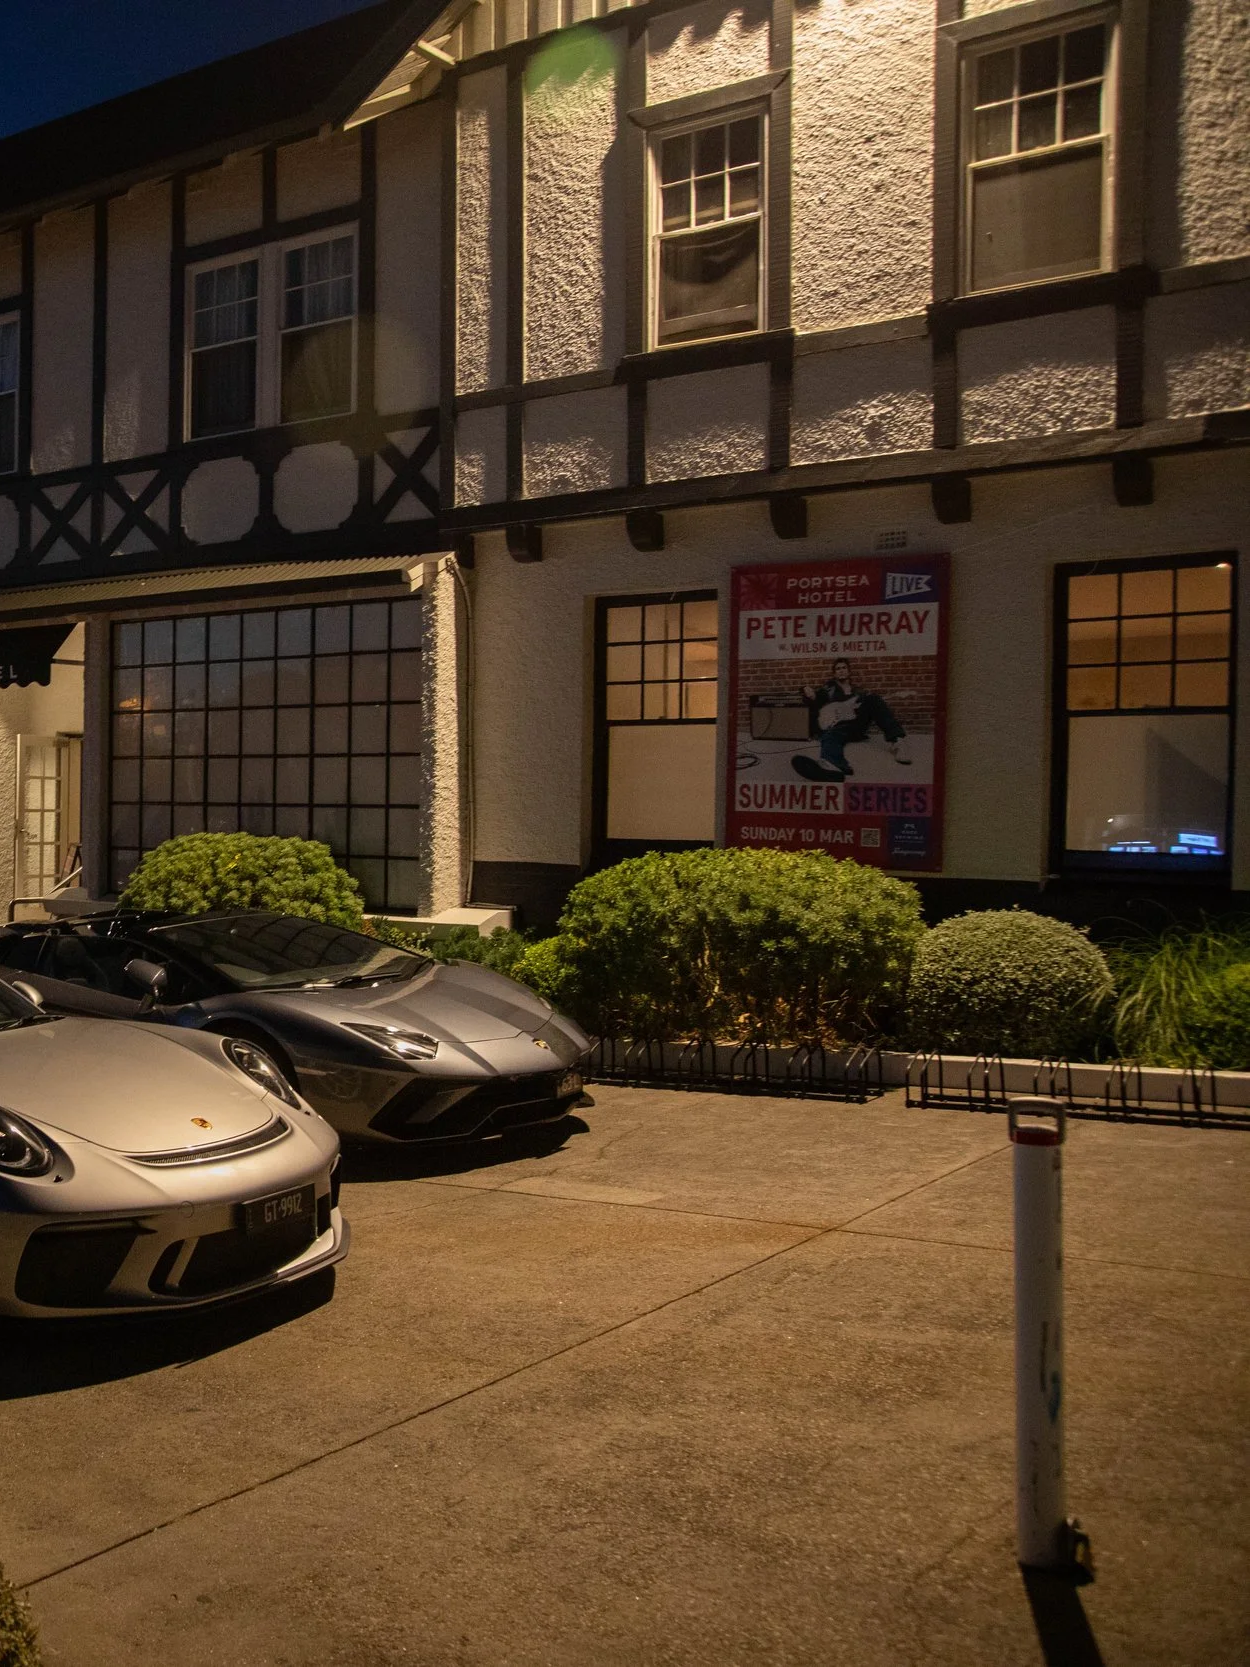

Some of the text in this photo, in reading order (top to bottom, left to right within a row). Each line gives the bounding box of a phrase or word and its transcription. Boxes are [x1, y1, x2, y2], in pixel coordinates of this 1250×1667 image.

[786, 575, 870, 590] PORTSEA
[892, 576, 923, 595] LIVE
[797, 591, 857, 604] HOTEL
[746, 609, 930, 640] PETE MURRAY
[791, 642, 827, 653] WILSN
[830, 641, 840, 652] &
[843, 640, 887, 652] MIETTA
[738, 783, 927, 814] SUMMER SERIES
[741, 826, 854, 844] SUNDAY 10 MAR
